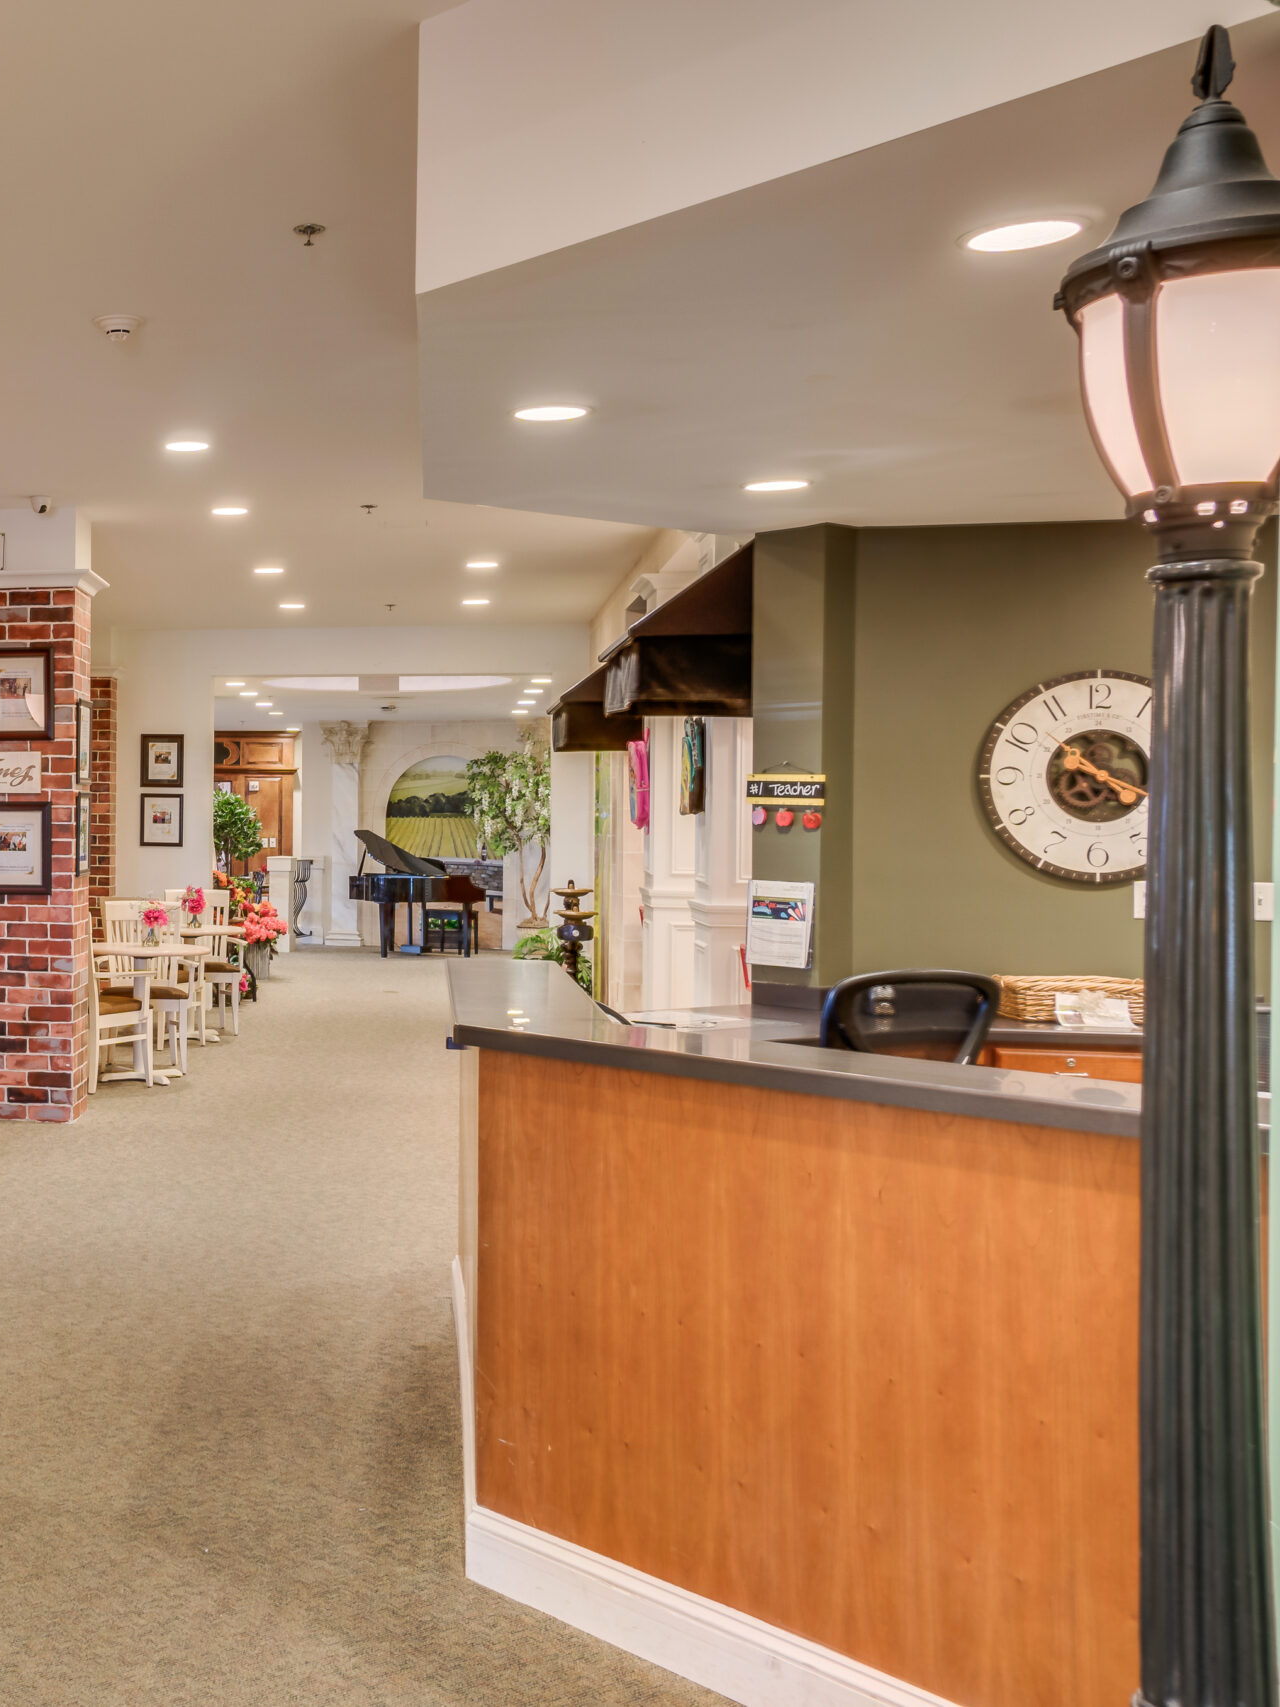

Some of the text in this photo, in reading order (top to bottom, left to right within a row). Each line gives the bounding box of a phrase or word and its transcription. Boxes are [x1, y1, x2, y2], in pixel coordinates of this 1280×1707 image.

[1043, 695, 1067, 721] 11
[1089, 684, 1112, 710] 12
[1005, 722, 1039, 752] 10
[769, 781, 820, 796] Teacher
[996, 766, 1025, 786] 9
[1008, 806, 1035, 826] 8
[1043, 830, 1068, 854] 7
[1087, 841, 1110, 868] 6
